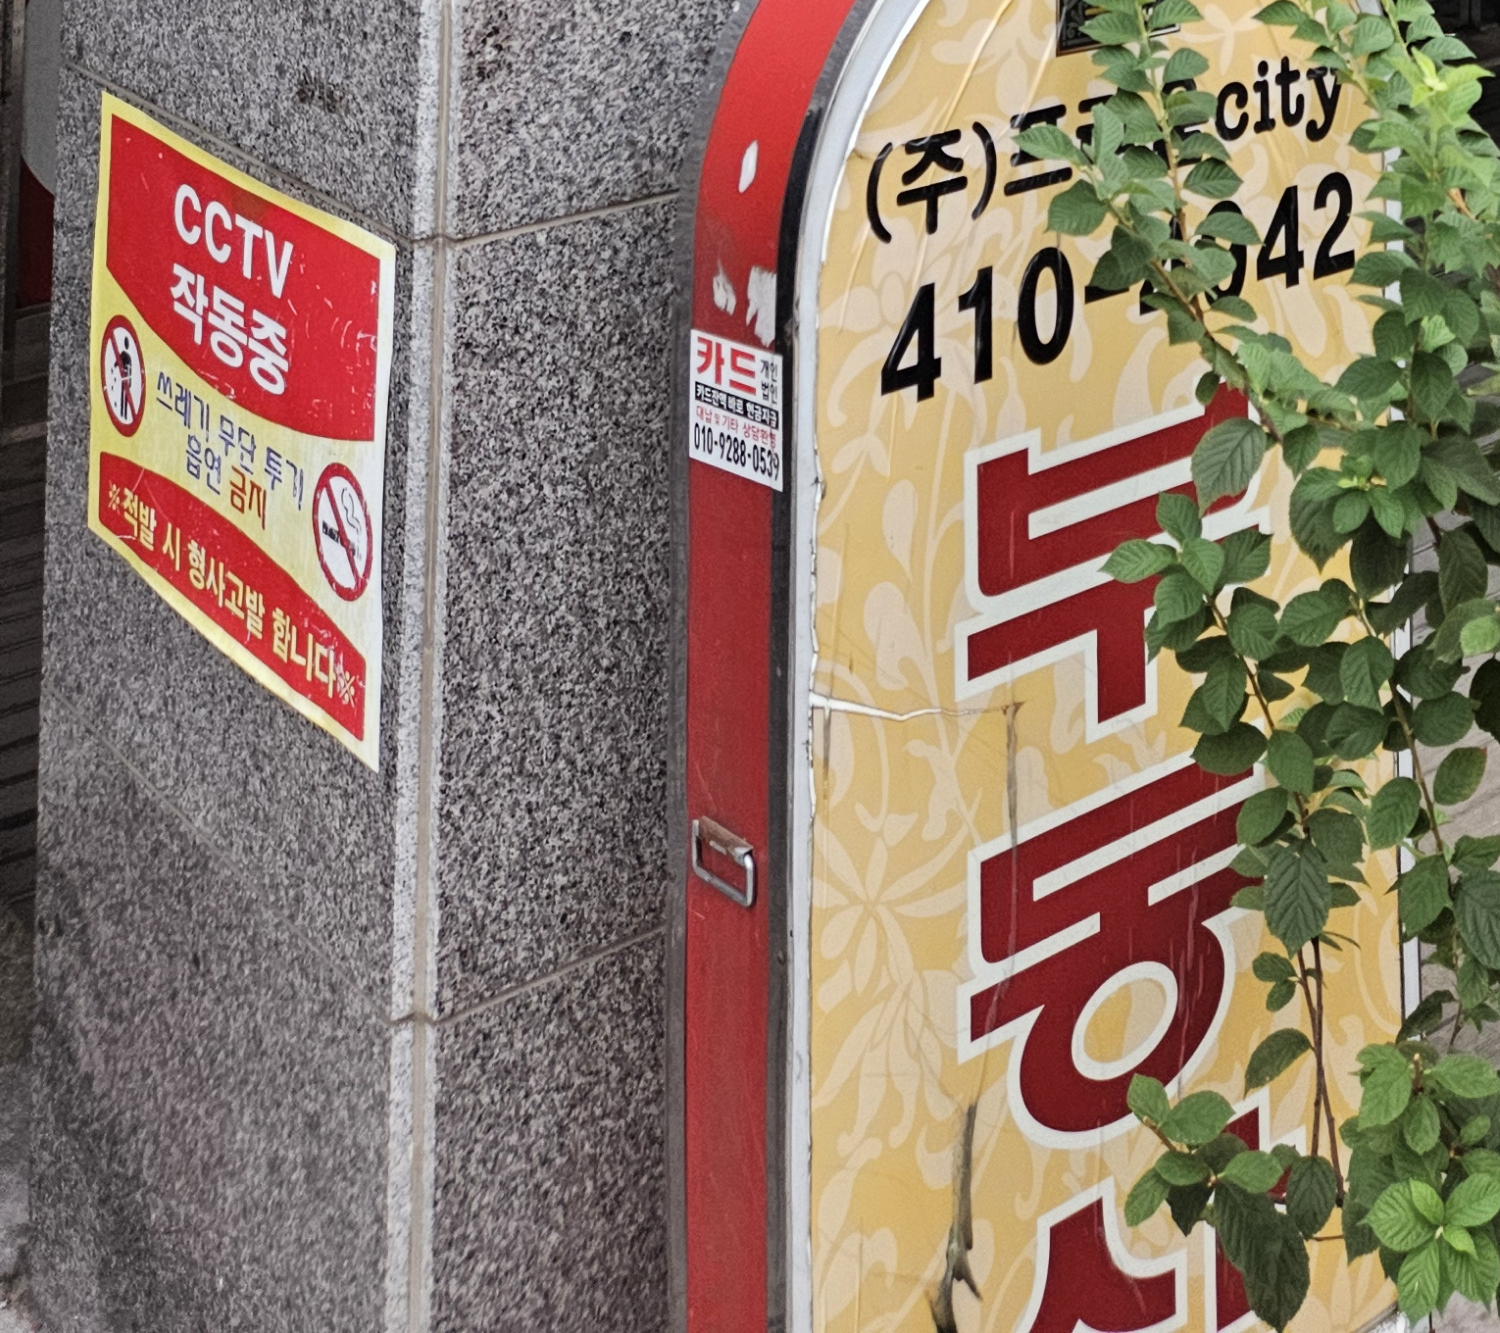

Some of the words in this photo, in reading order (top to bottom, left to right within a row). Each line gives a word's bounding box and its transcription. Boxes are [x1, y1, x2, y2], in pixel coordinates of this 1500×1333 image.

[173, 183, 294, 301] CCTV
[170, 264, 290, 396] 작동중
[696, 382, 727, 409] 카드잔액
[697, 336, 757, 396] 카드
[761, 360, 778, 383] 개인
[761, 381, 778, 405] 법인
[156, 370, 211, 442] 쓰레기
[218, 409, 257, 473] 무단
[264, 439, 306, 513] 투기
[696, 405, 712, 424] 대납
[722, 415, 739, 434] 기타
[186, 433, 223, 497] 흡연
[229, 470, 268, 531] 금지
[694, 423, 780, 481] 010-9288-0539
[161, 515, 182, 574] 시
[187, 536, 267, 639] 형사고발
